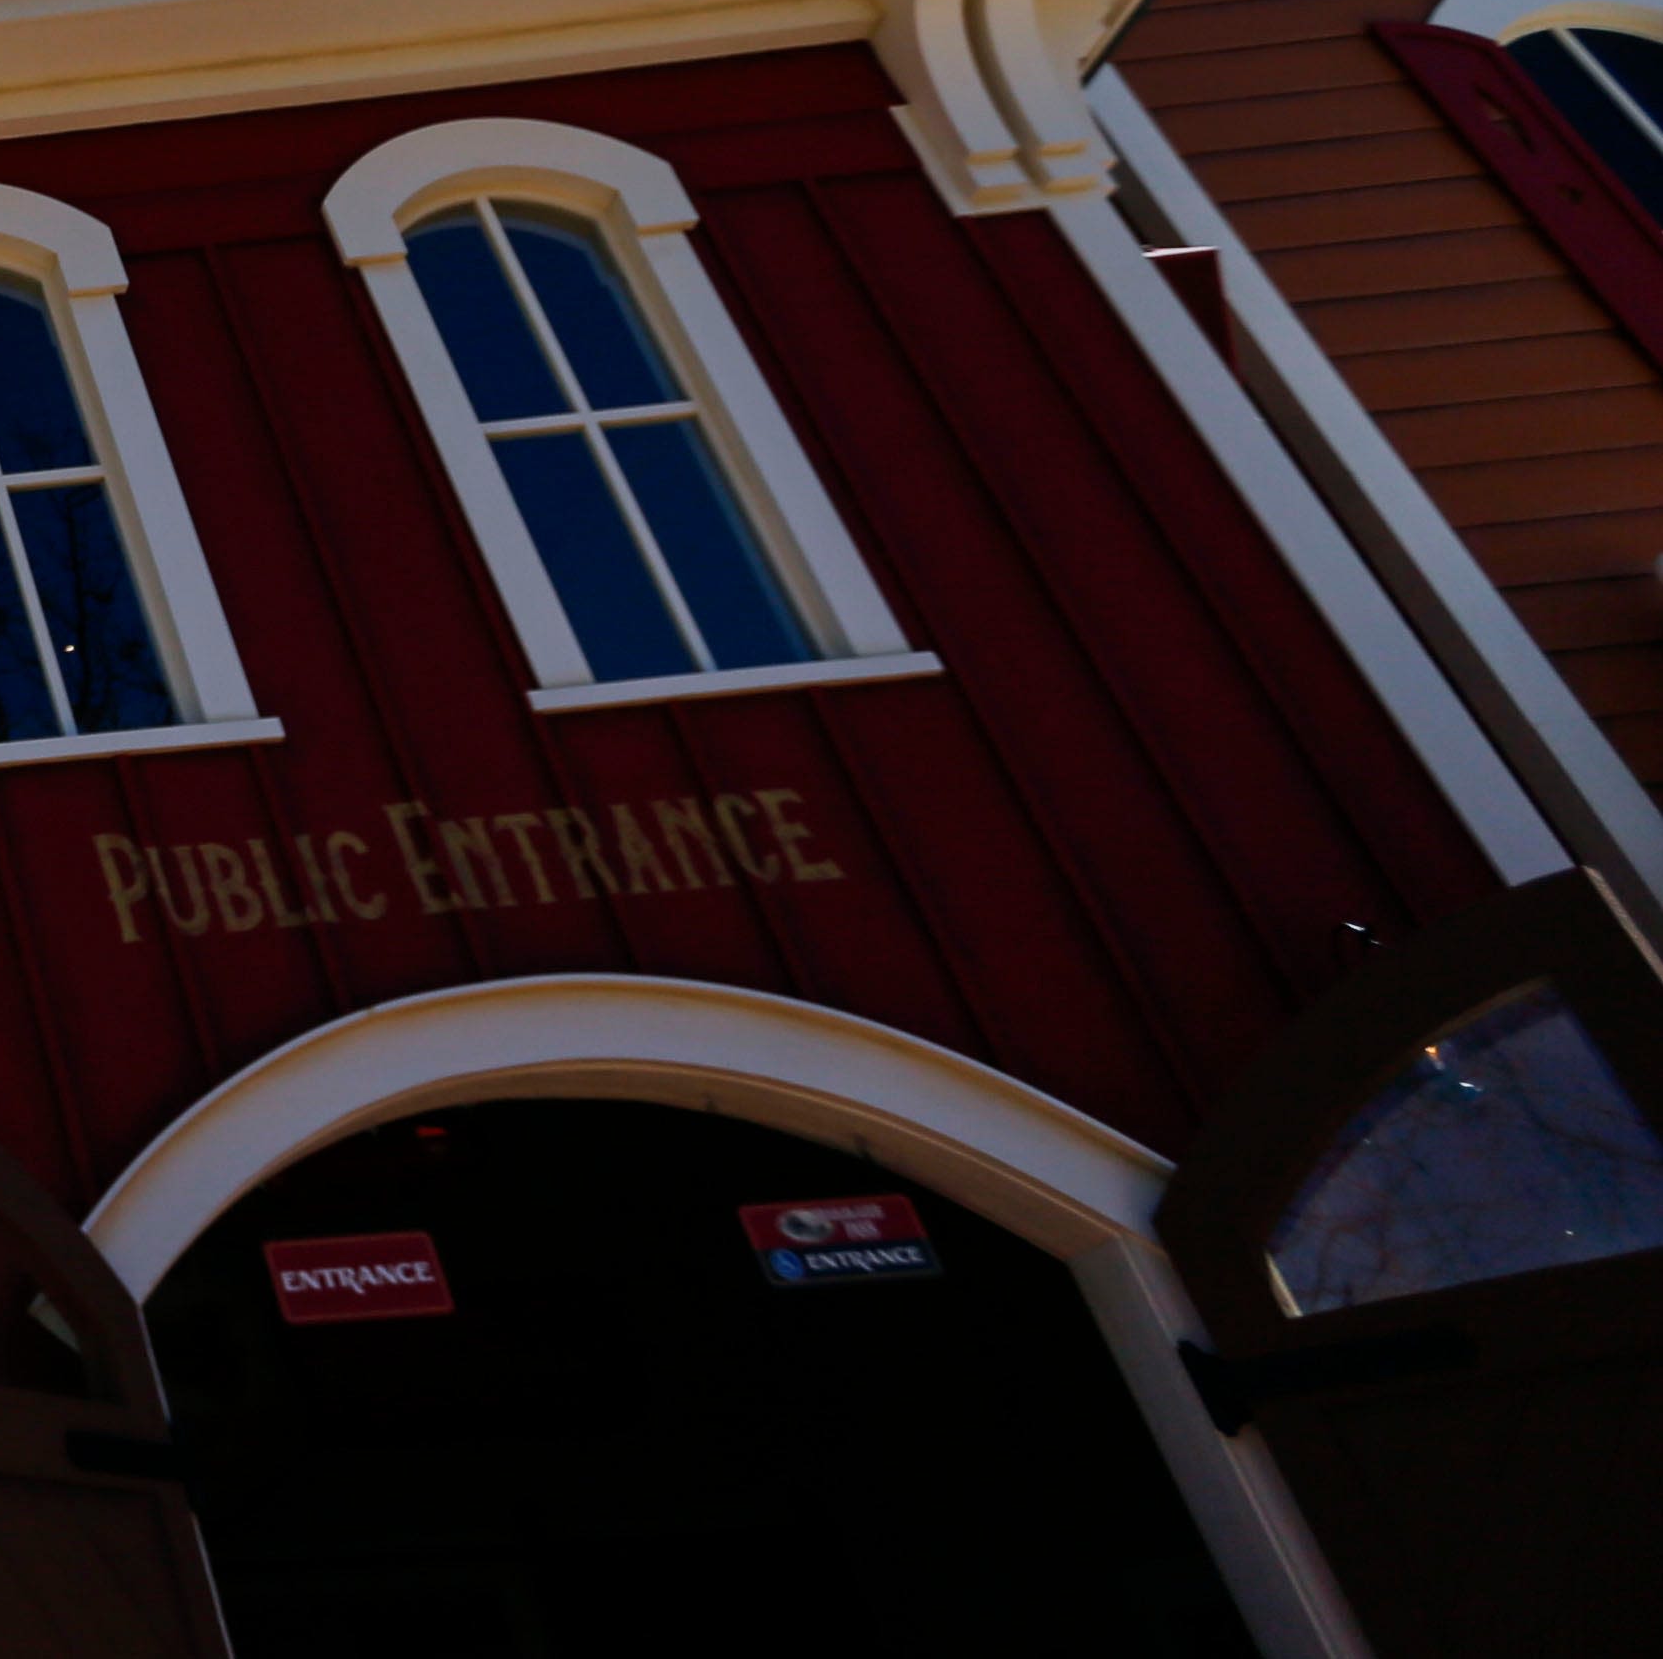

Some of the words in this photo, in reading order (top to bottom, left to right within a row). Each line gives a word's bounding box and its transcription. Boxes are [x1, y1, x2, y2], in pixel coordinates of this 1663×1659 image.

[93, 829, 389, 943] PUBLIC
[384, 787, 846, 917] ENTRANCE
[803, 1245, 926, 1273] ENTRANCE
[280, 1260, 436, 1295] ENTRANCE
